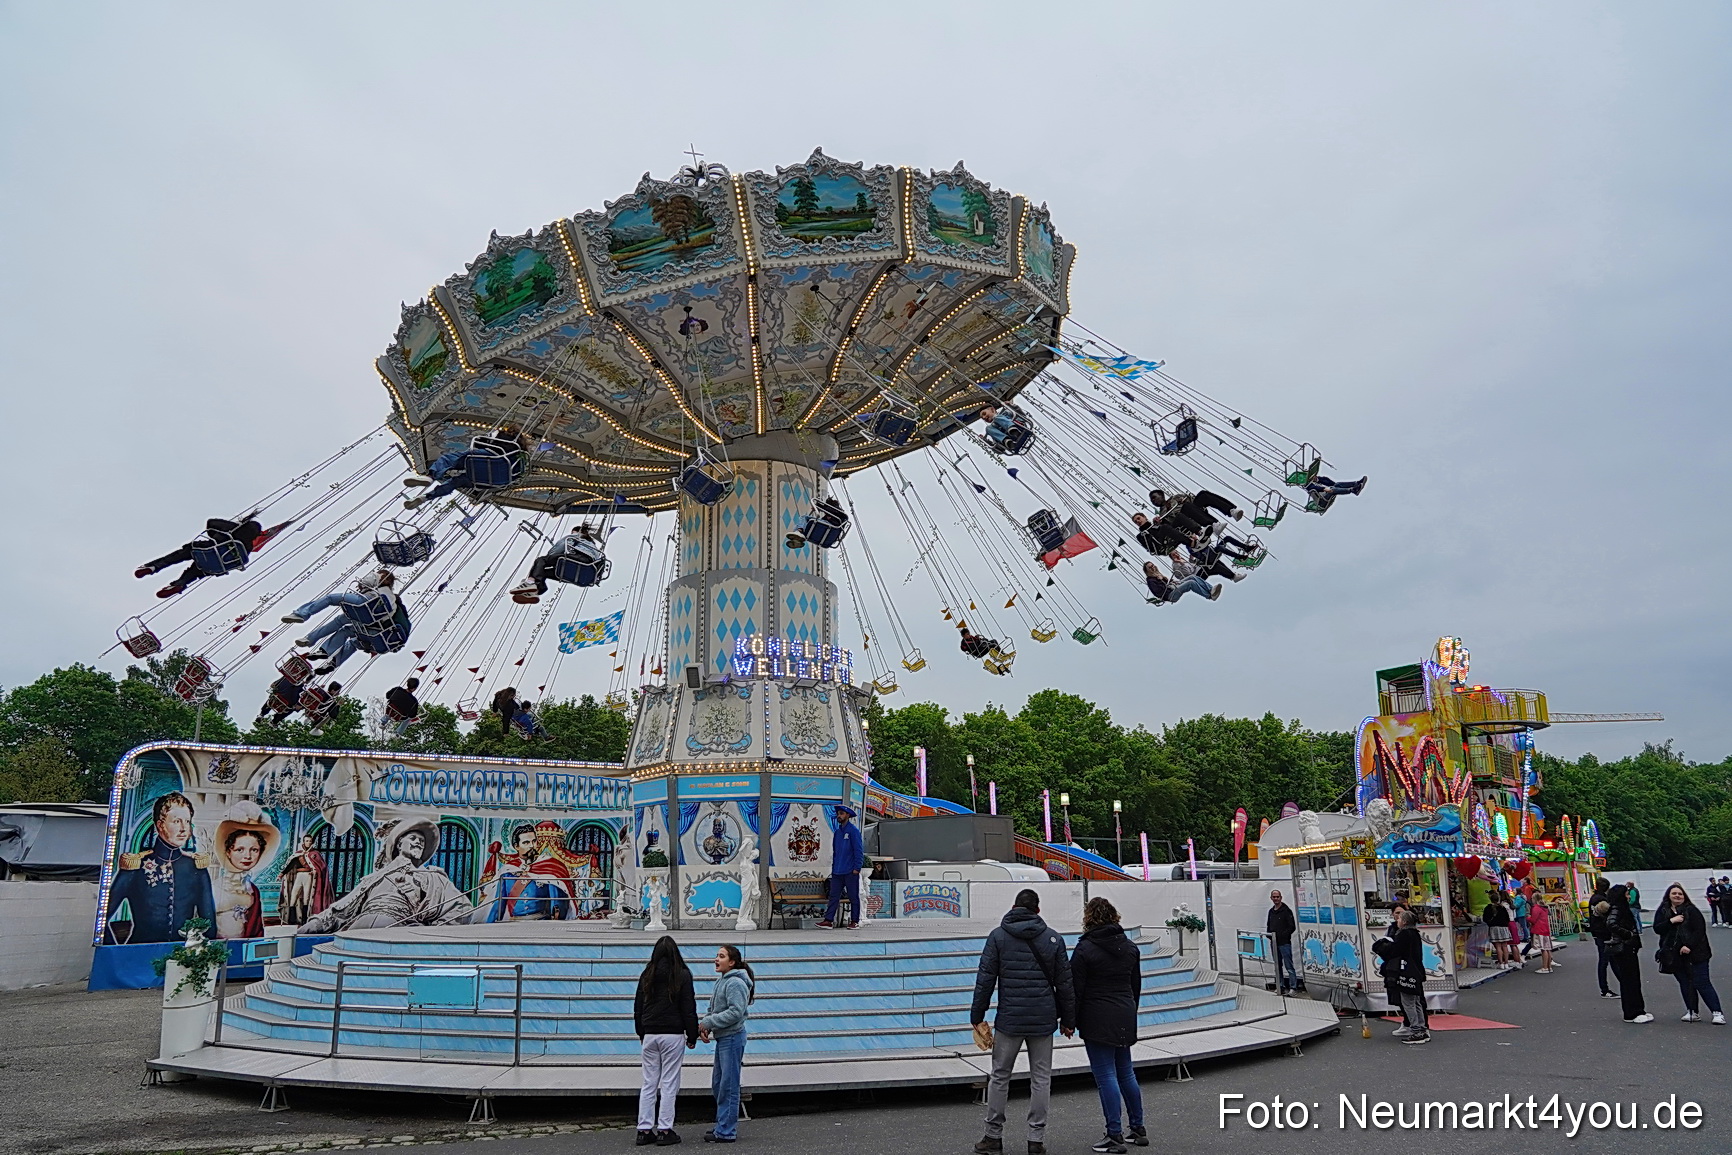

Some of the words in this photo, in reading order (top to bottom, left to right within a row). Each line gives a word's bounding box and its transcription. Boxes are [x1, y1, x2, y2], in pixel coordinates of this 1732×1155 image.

[735, 633, 854, 668] KÖNIGLICHER
[369, 764, 528, 810] KÖNIGLICHER
[912, 885, 950, 897] EURO
[904, 899, 960, 915] RUTSCHE
